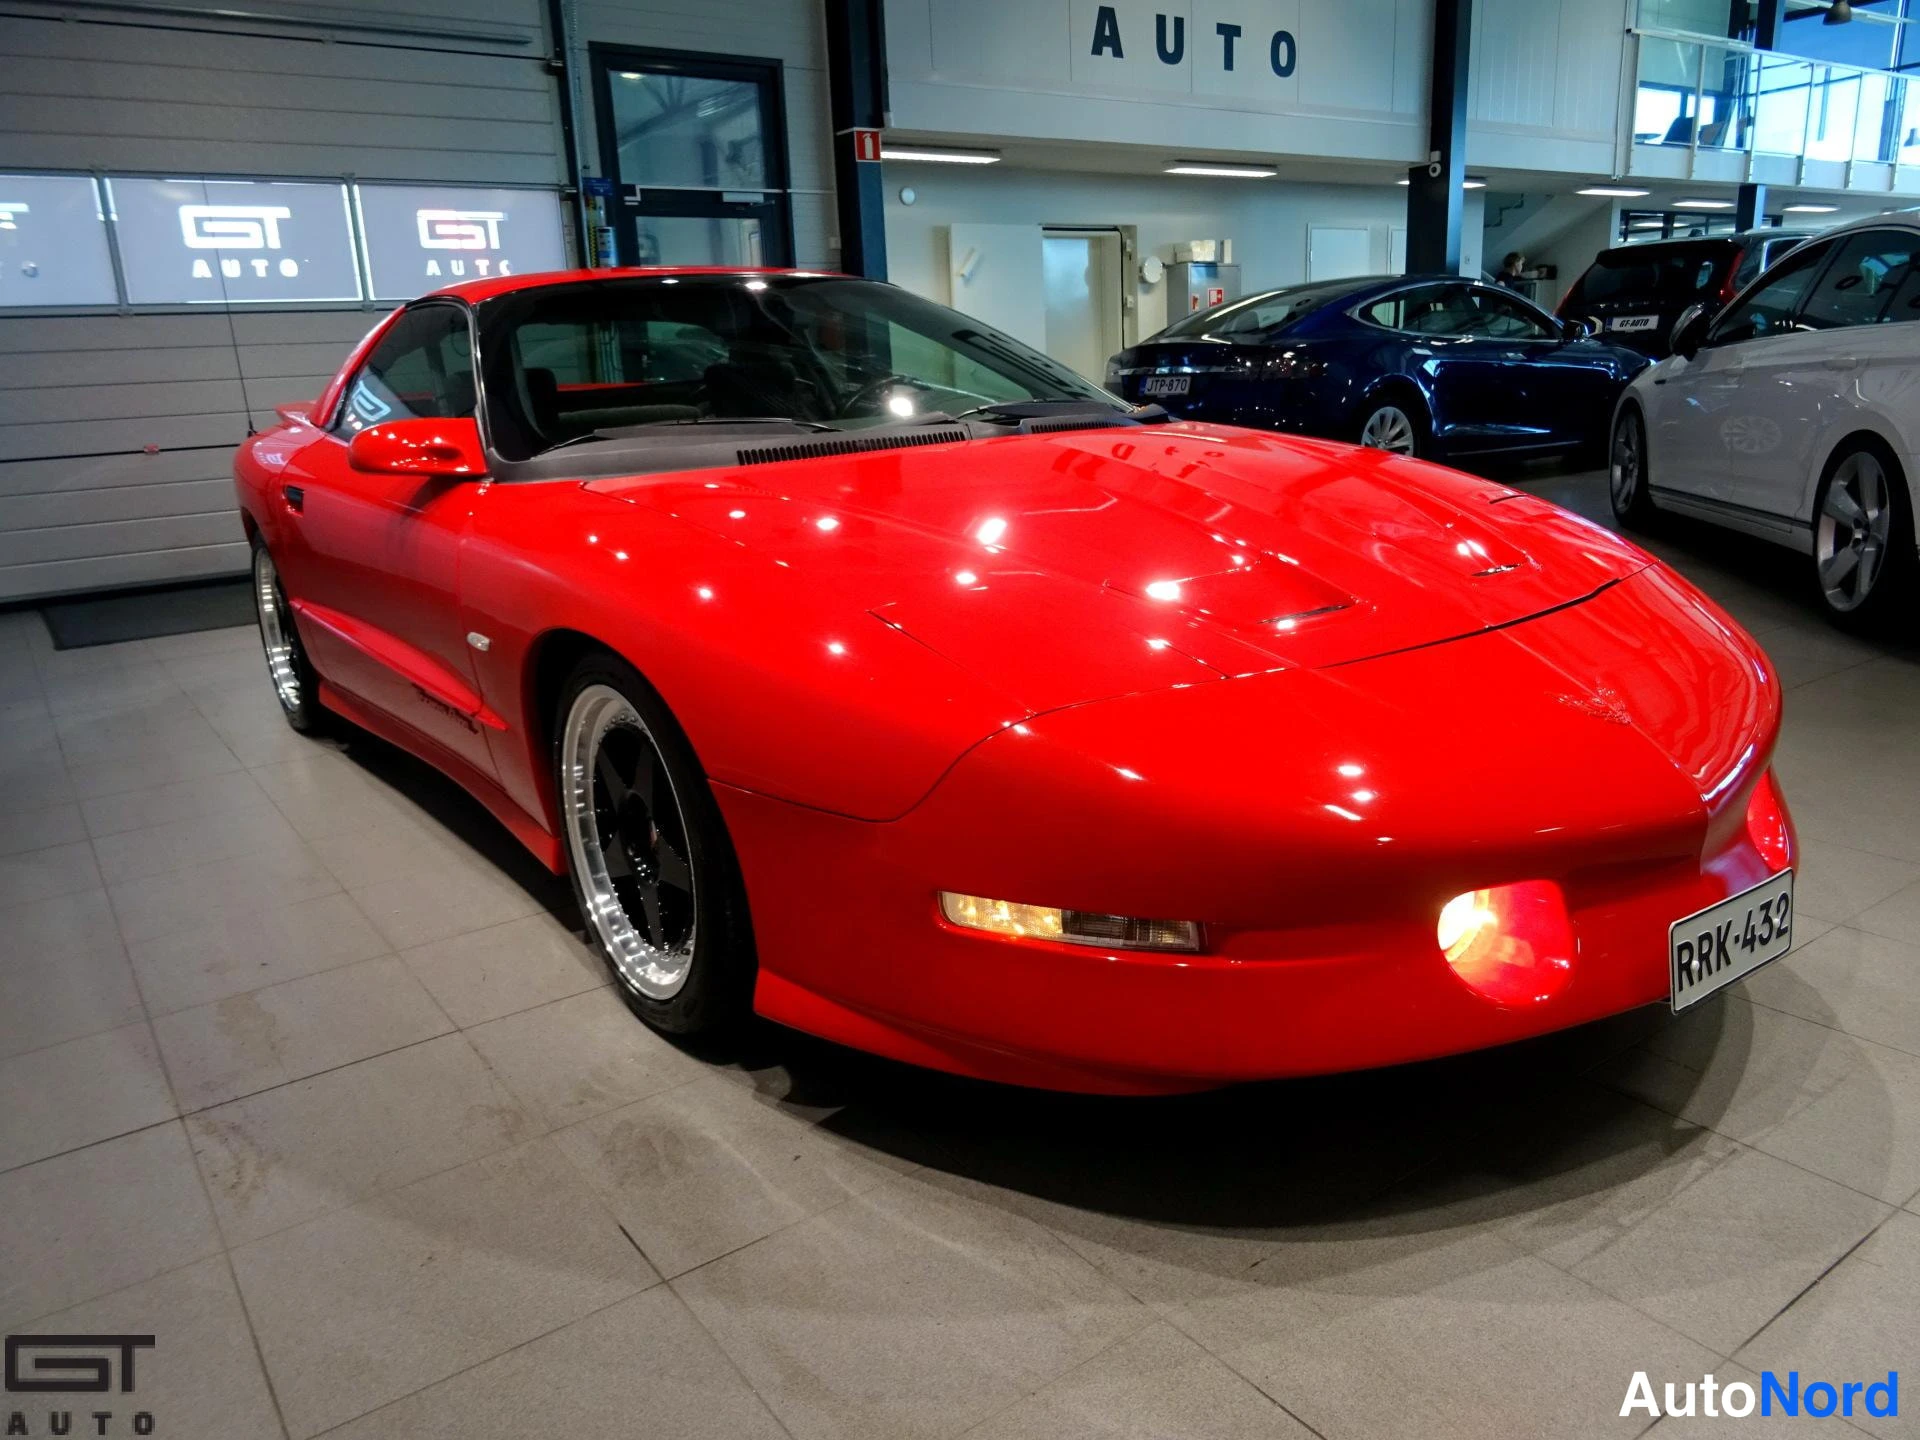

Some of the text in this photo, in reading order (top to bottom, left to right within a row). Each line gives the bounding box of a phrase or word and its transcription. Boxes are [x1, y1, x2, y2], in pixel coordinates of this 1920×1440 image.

[1091, 5, 1297, 78] AUTO
[179, 205, 291, 249] GT
[192, 258, 299, 278] AUTO
[1618, 318, 1650, 328] GT-AUTO
[1147, 378, 1188, 392] JTP-870
[1676, 892, 1790, 993] RRK-432
